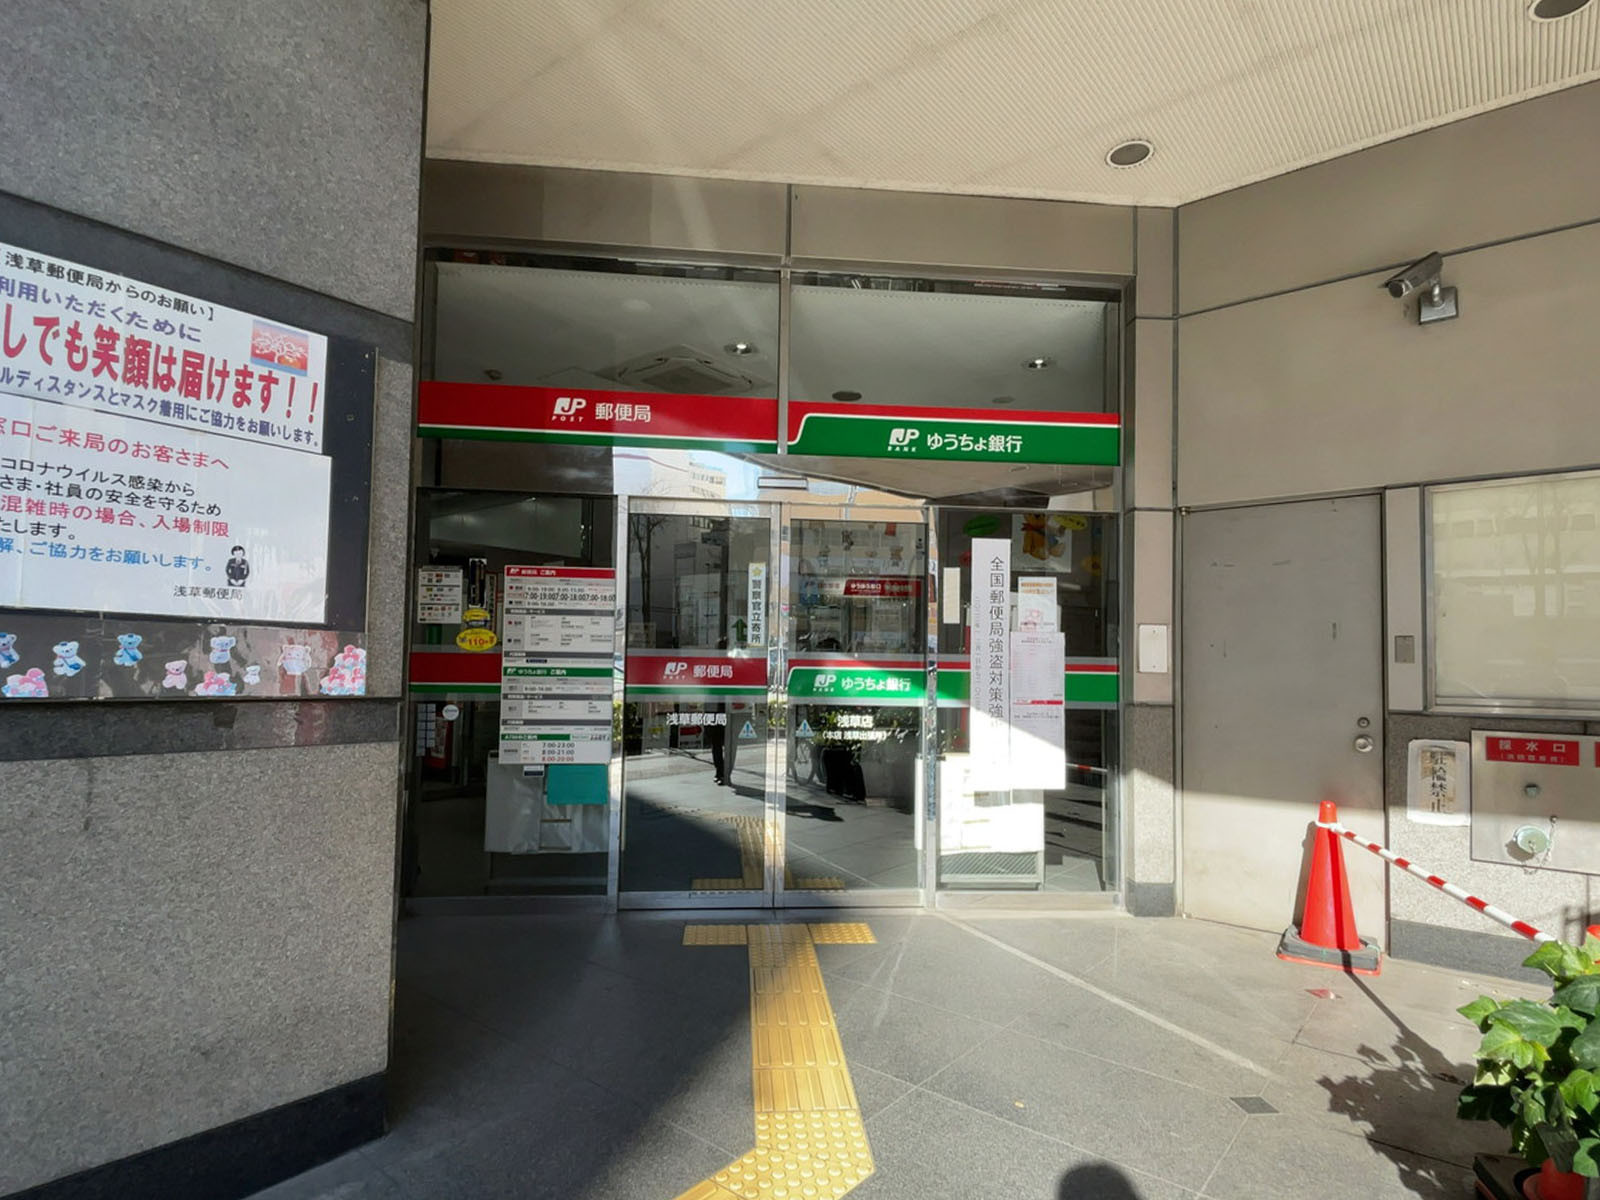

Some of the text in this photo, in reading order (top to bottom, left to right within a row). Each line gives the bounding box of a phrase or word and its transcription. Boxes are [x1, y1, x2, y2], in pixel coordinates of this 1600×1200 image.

[0, 275, 203, 344] 利用いただくために
[3, 303, 319, 423] しでも笑顔は届けます！！
[595, 402, 652, 423] 郵便局
[927, 432, 1023, 453] ゆうちょ銀行
[1, 457, 195, 497] コロナウイルス感染から
[0, 474, 222, 517] さま・社員の安全を守るため
[1, 494, 230, 538] 混雑時の場合、入場制限
[173, 584, 243, 601] 浅草郵便局
[693, 665, 733, 679] 郵便局
[841, 677, 912, 692] ゆうちょ銀行
[666, 712, 727, 726] 浅草郵便局
[837, 714, 874, 728] 浅草店
